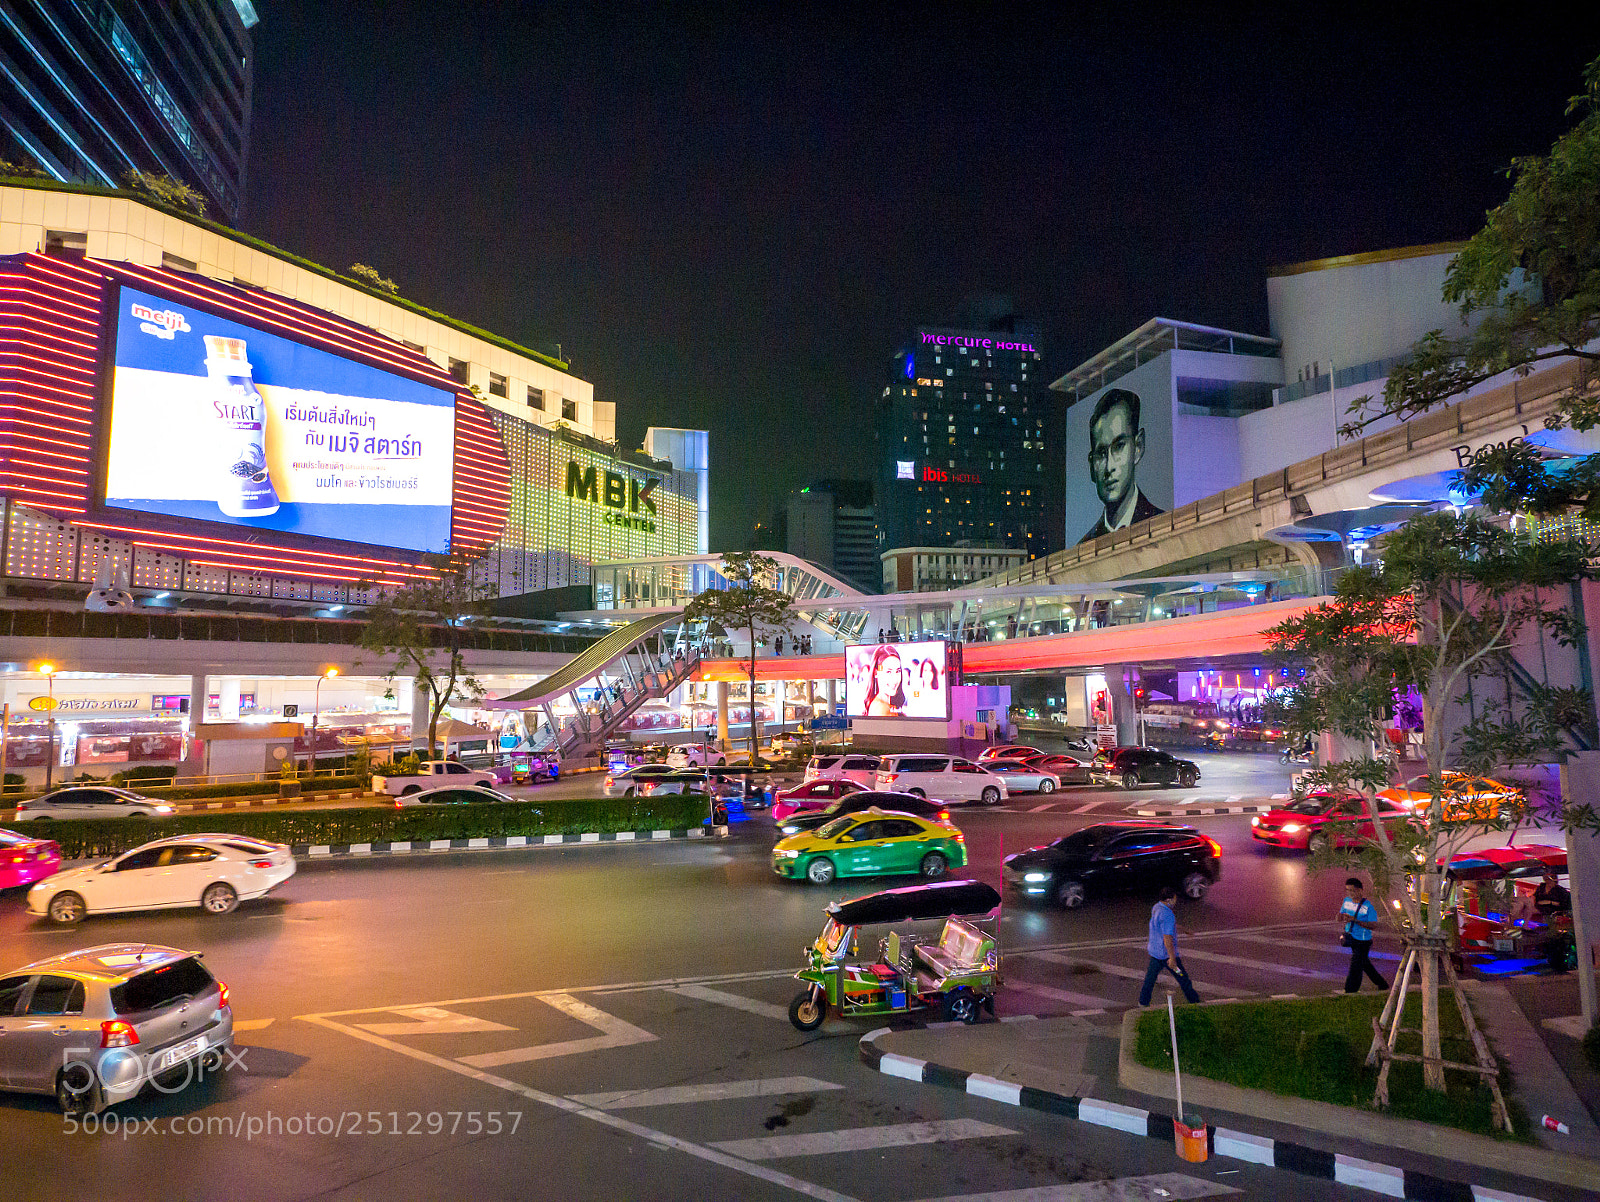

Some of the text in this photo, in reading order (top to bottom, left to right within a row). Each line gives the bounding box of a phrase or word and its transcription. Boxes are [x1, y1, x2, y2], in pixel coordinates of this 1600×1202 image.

[134, 306, 182, 330] meiji
[920, 331, 1036, 352] mercure HOTEL
[213, 400, 256, 421] START
[285, 401, 376, 432] เริ่มต้นสิ่งใหม่ๆ
[305, 429, 422, 457] กับ เมจิ สตาร์ท
[923, 466, 948, 482] ibis
[952, 473, 982, 484] HOTEL
[567, 460, 661, 517] MBK
[604, 511, 656, 534] CENTER
